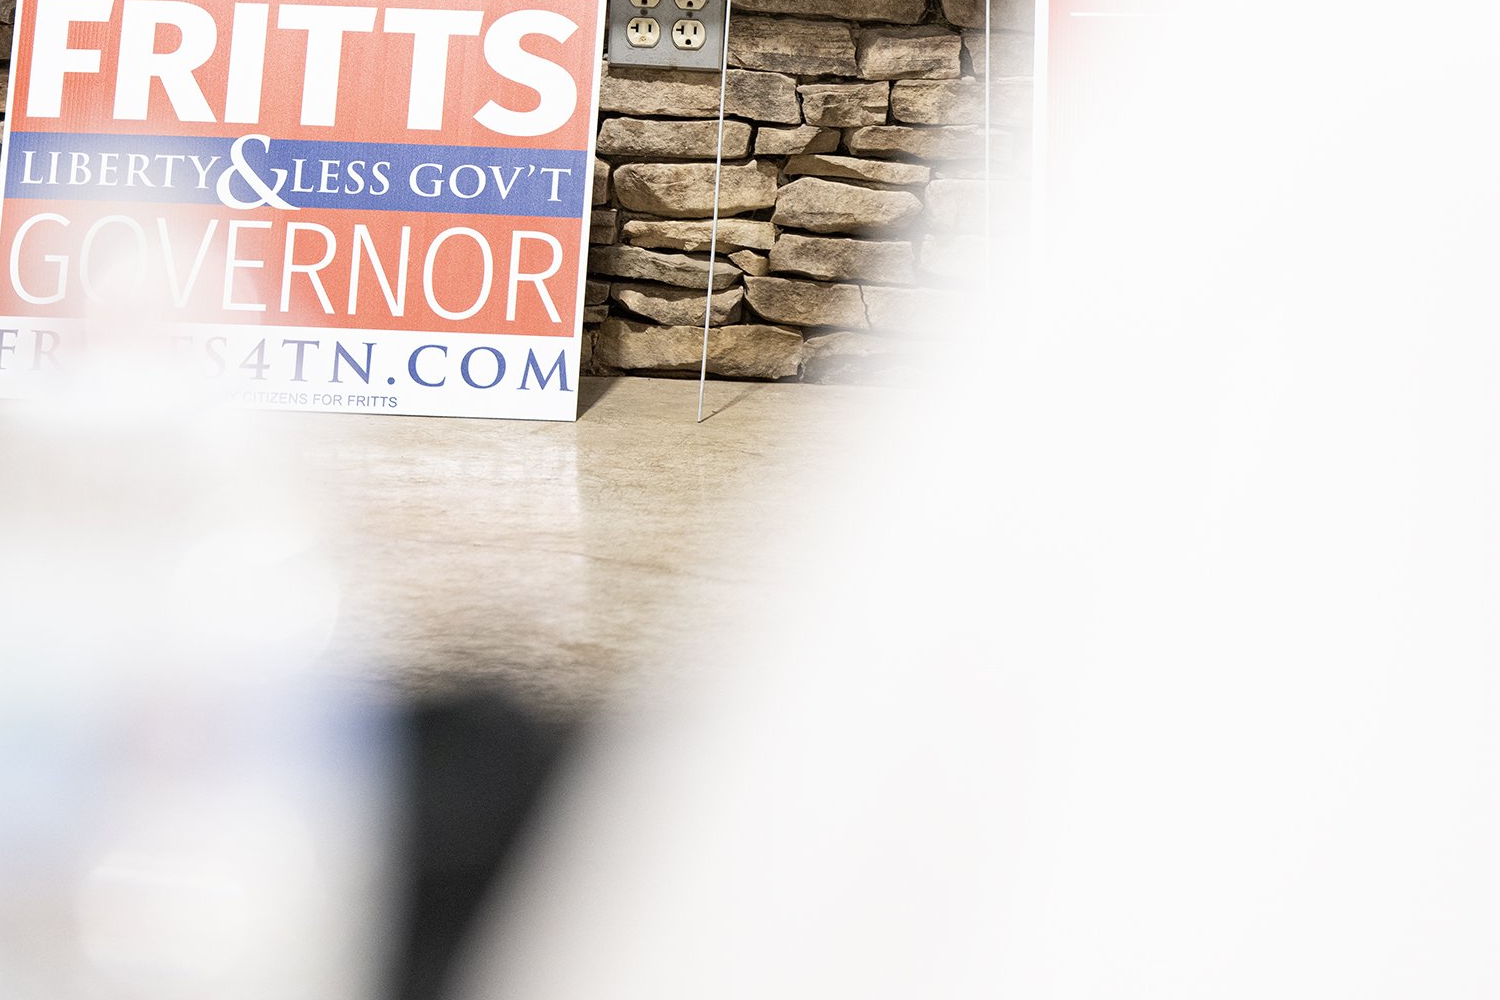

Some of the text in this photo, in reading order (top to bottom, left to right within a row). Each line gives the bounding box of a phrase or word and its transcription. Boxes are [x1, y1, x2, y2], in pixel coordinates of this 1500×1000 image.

[20, 134, 572, 211] LIBERTY & LESS GOV'T
[7, 212, 564, 324] GOVERNOR
[242, 391, 308, 405] CITIZENS
[312, 394, 343, 406] FOR
[347, 395, 399, 408] FRITTS
